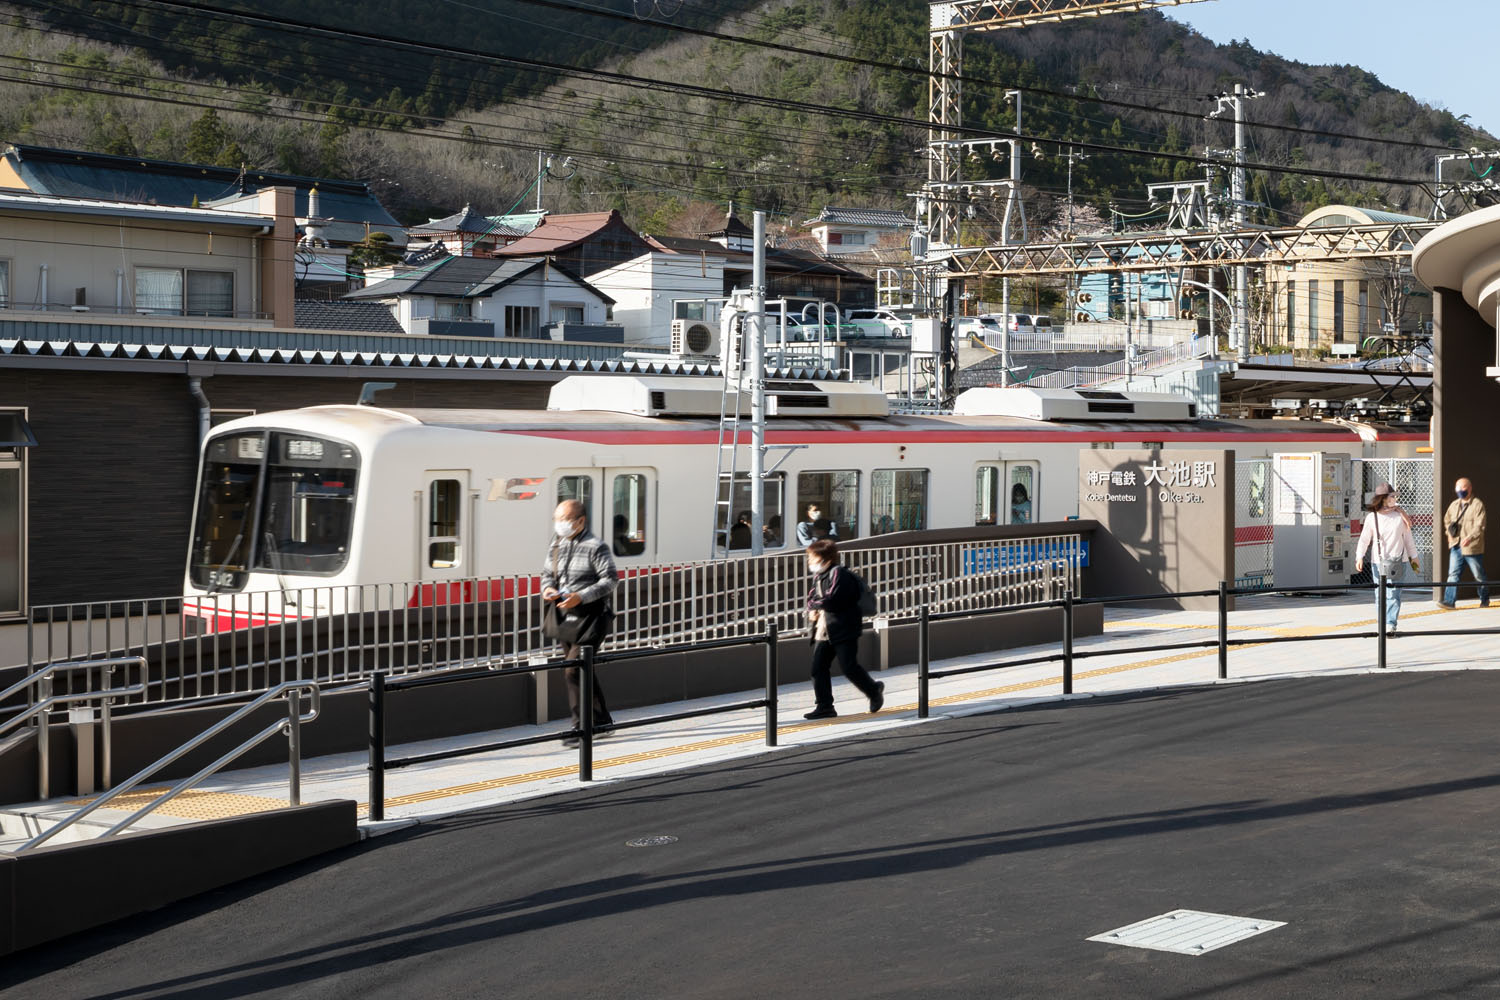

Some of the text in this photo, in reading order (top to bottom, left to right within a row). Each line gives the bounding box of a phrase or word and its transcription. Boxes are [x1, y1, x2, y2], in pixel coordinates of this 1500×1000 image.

[1086, 460, 1217, 488] 神戸電鉄 大池駅
[1086, 491, 1205, 503] Kobe Dentetsu Oike Sta.
